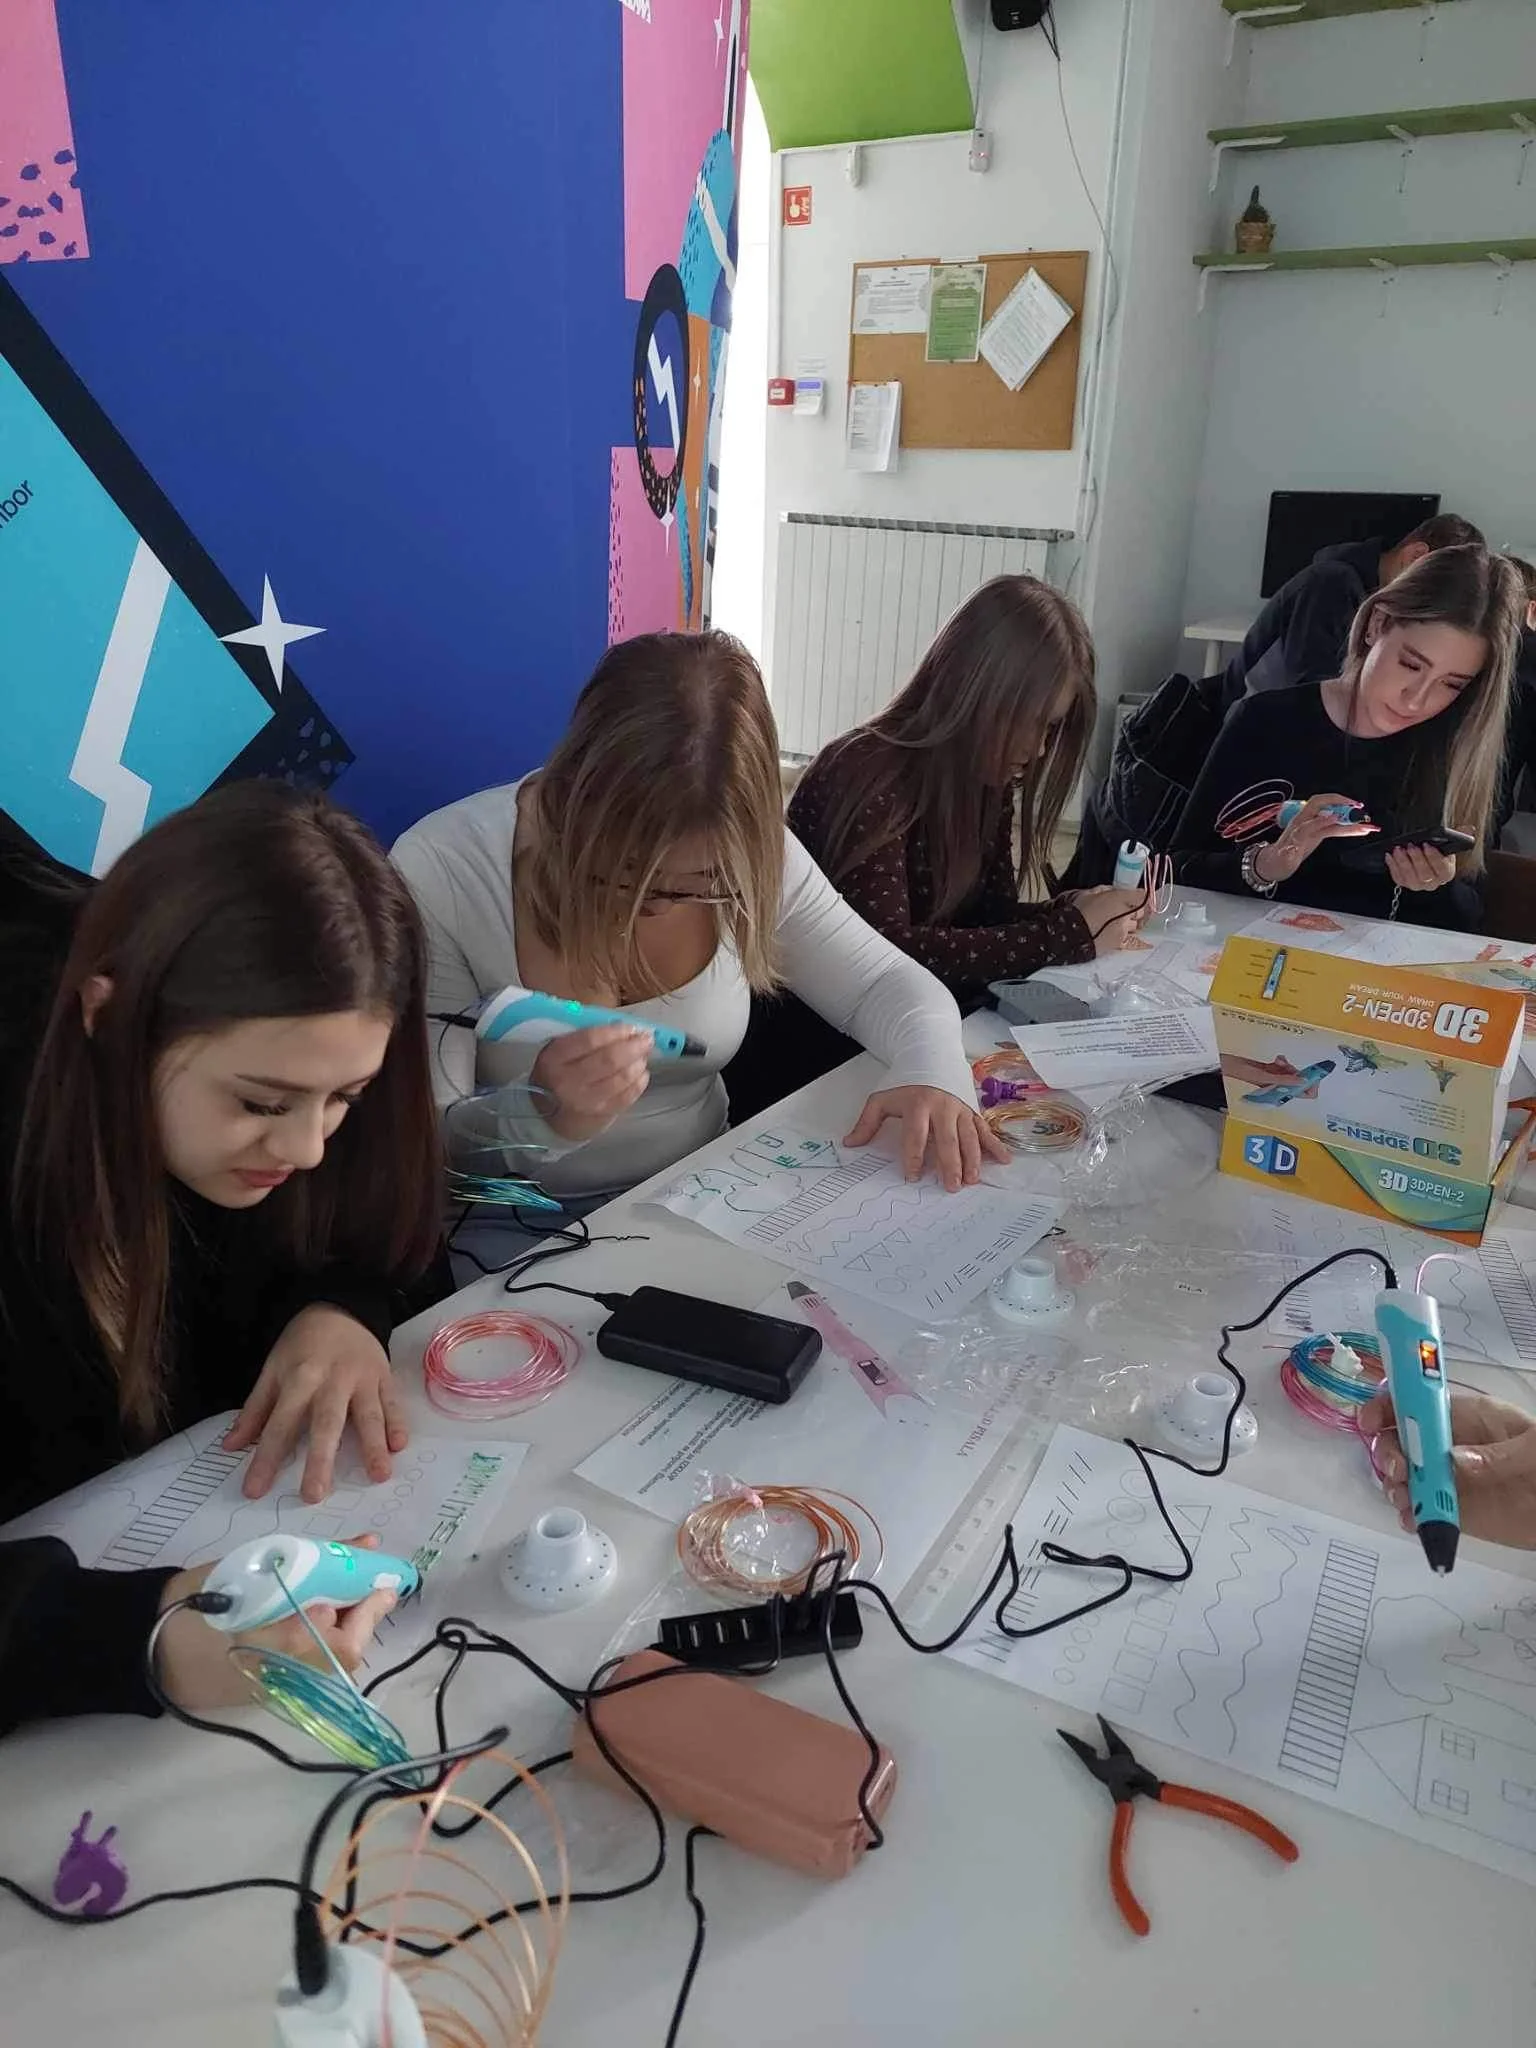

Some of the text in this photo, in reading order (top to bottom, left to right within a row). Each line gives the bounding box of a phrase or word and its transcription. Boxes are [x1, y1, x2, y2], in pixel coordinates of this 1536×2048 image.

[1342, 994, 1432, 1030] 3DPEN-2
[1433, 1002, 1489, 1044] 3D
[1326, 1120, 1410, 1151] 3DPEN-2
[1413, 1137, 1463, 1166] 3D
[1248, 1138, 1296, 1171] 3D
[1378, 1168, 1409, 1192] 3D
[1409, 1178, 1465, 1202] 3DPEN-2
